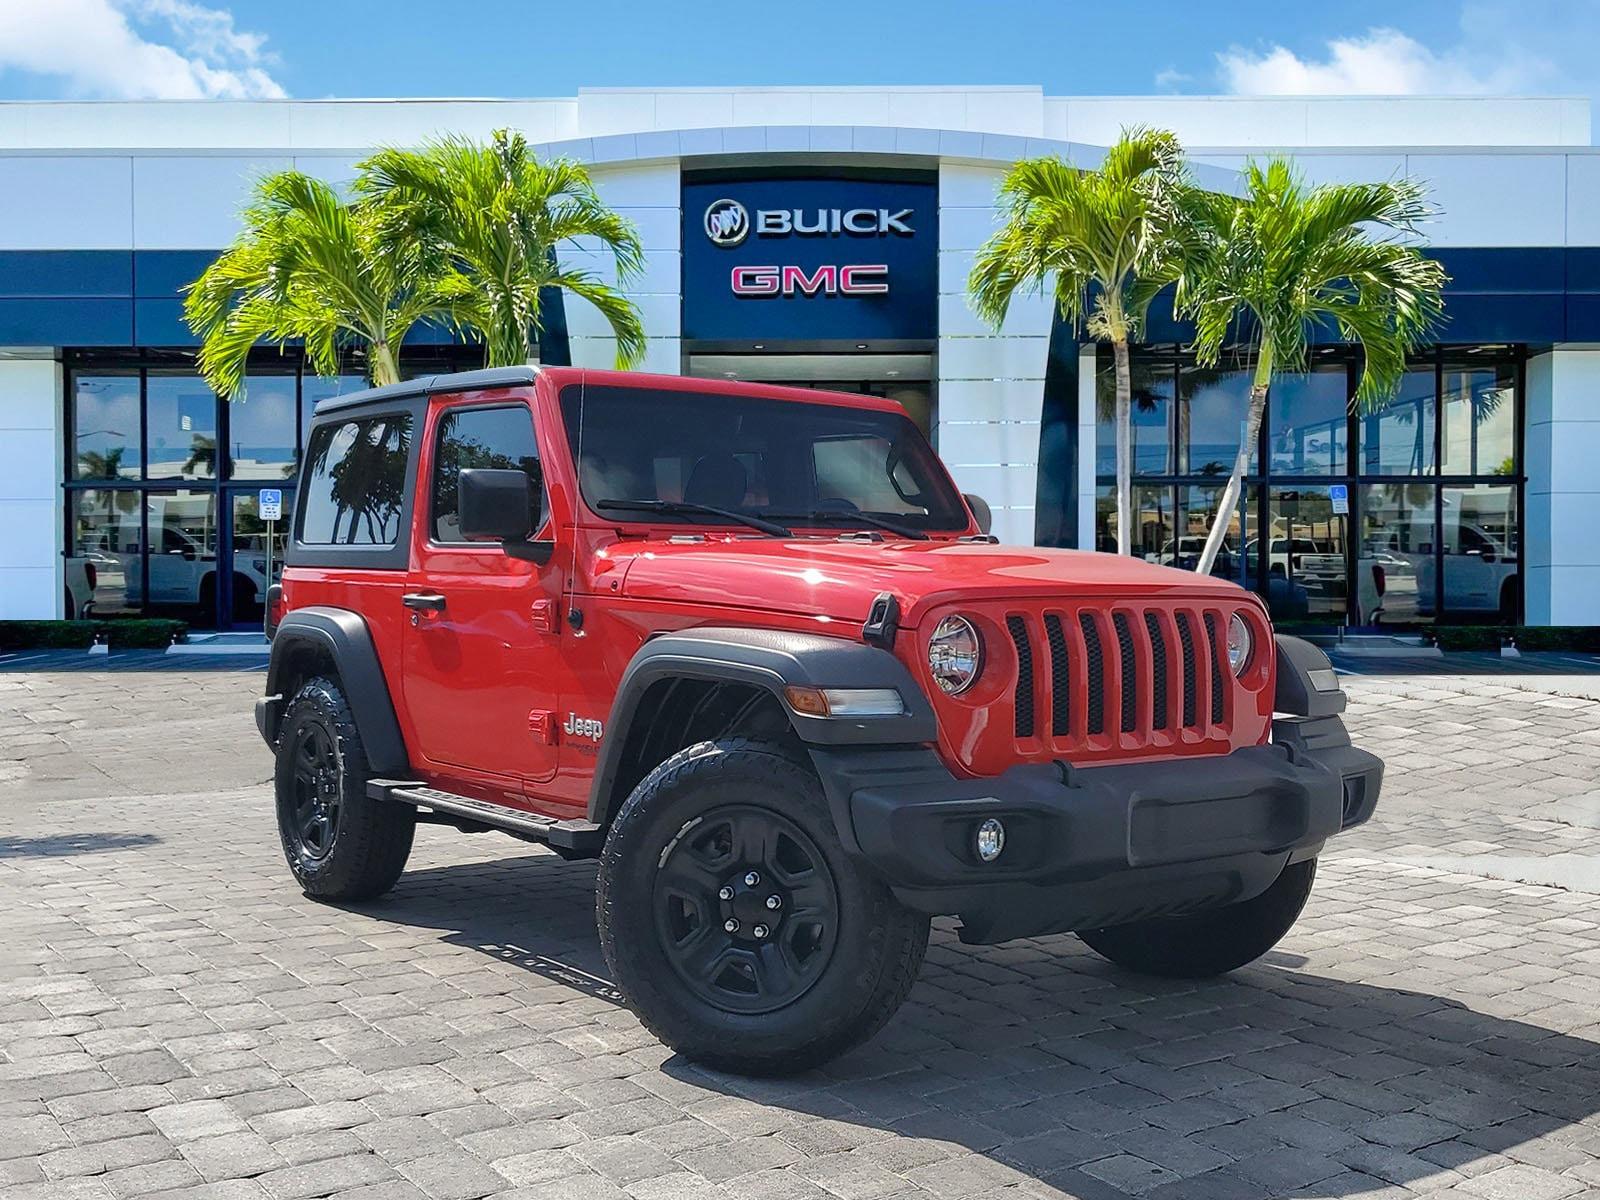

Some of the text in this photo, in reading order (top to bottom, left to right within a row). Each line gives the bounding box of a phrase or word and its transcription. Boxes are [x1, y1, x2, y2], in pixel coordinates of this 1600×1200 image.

[757, 208, 915, 233] BUICK
[731, 264, 889, 295] GMC
[563, 711, 603, 742] Jeep
